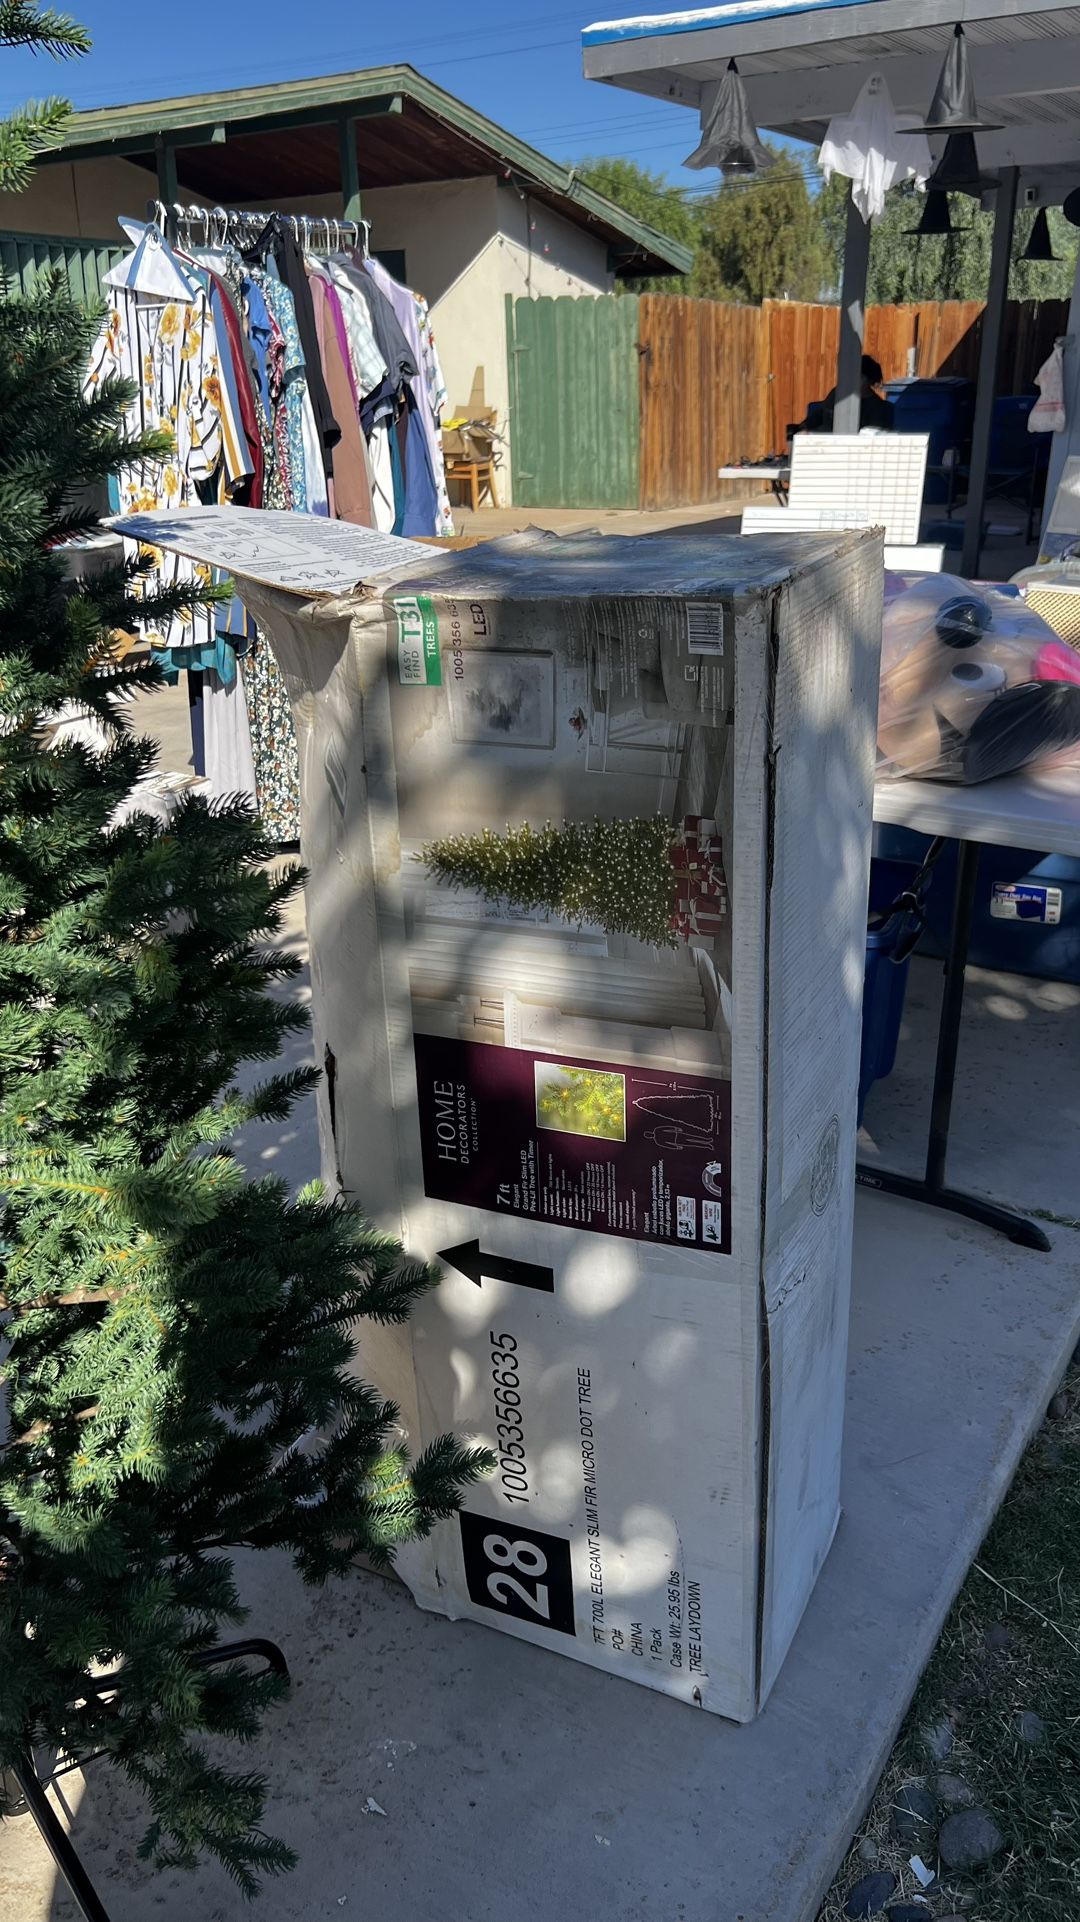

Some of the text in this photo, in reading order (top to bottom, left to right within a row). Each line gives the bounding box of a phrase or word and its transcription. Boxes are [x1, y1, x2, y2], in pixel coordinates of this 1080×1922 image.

[452, 622, 461, 646] 356
[470, 604, 487, 635] LED
[426, 622, 436, 657] TREES
[404, 650, 412, 678] EASY
[412, 651, 421, 677] FIND
[454, 650, 464, 680] 1005
[434, 1081, 457, 1161] HOME
[457, 1085, 469, 1163] DECORATORS
[497, 1184, 510, 1204] 7 ft
[490, 1331, 529, 1503] 1005356635
[578, 1368, 605, 1644] 7FT 700L ELEGANT SLIM FIR MICRO DOT TREE
[483, 1534, 550, 1619] 28
[668, 1571, 682, 1667] Case Wt: 25.95 lbs
[688, 1581, 702, 1672] TREE LAYDOWN
[612, 1628, 624, 1651] PO#
[631, 1623, 643, 1656] CHINA
[650, 1628, 662, 1654] Pack
